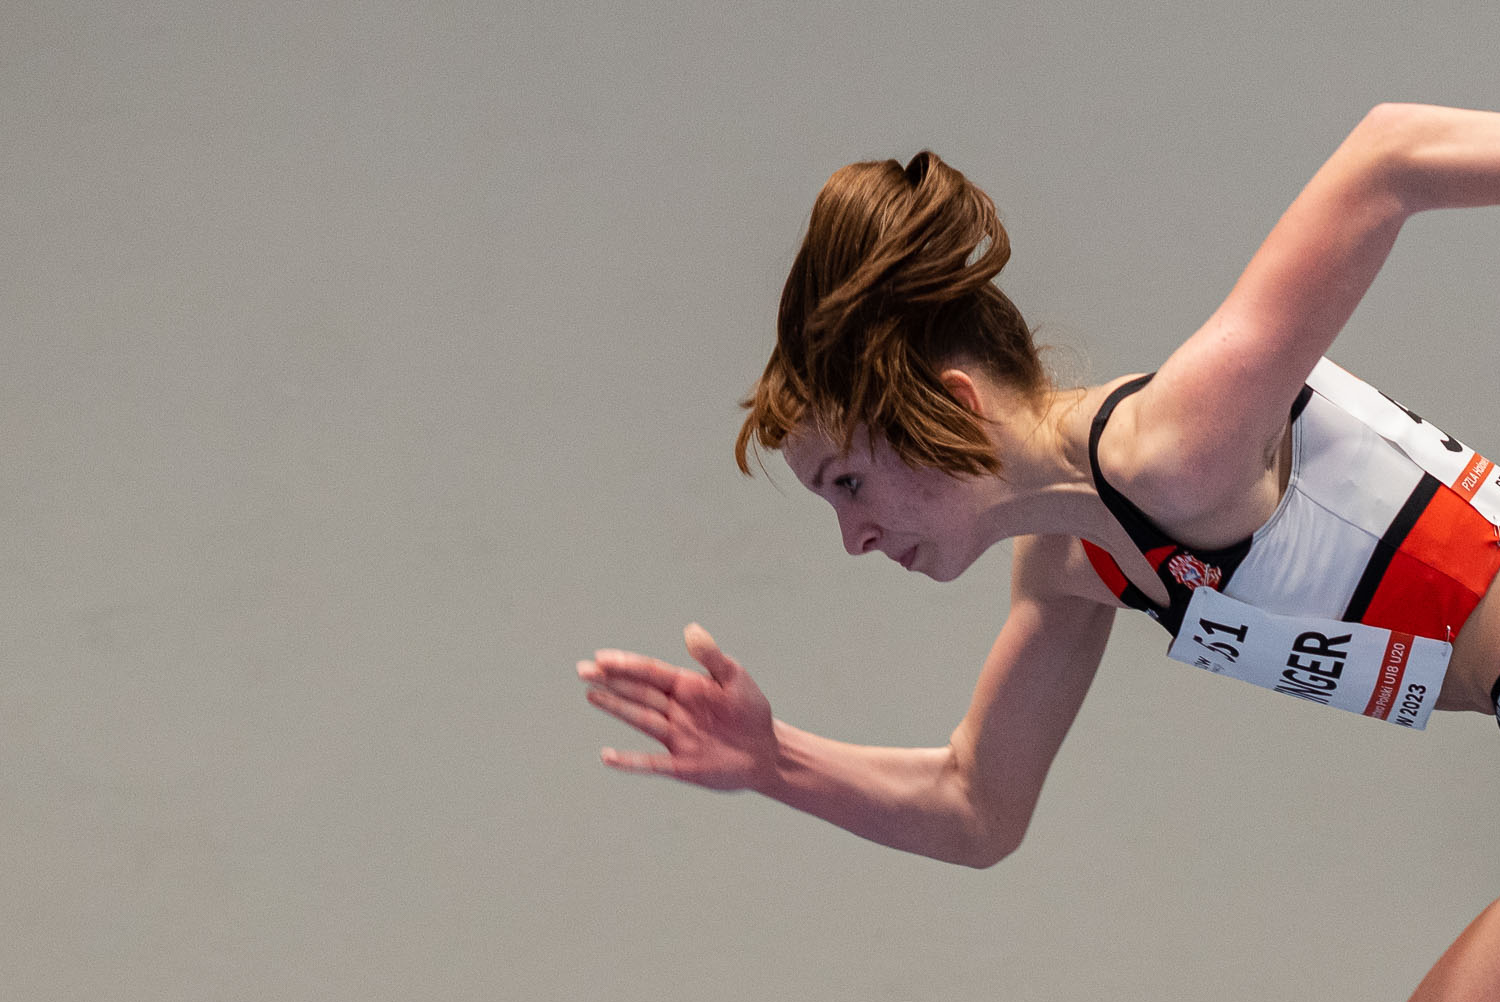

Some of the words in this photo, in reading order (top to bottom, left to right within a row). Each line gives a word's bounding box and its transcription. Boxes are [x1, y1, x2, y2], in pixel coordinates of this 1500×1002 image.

[1461, 472, 1480, 492] PZLA
[1390, 643, 1406, 664] U20
[1384, 666, 1399, 685] U18
[1376, 686, 1393, 708] Polski
[1399, 683, 1427, 717] 2023
